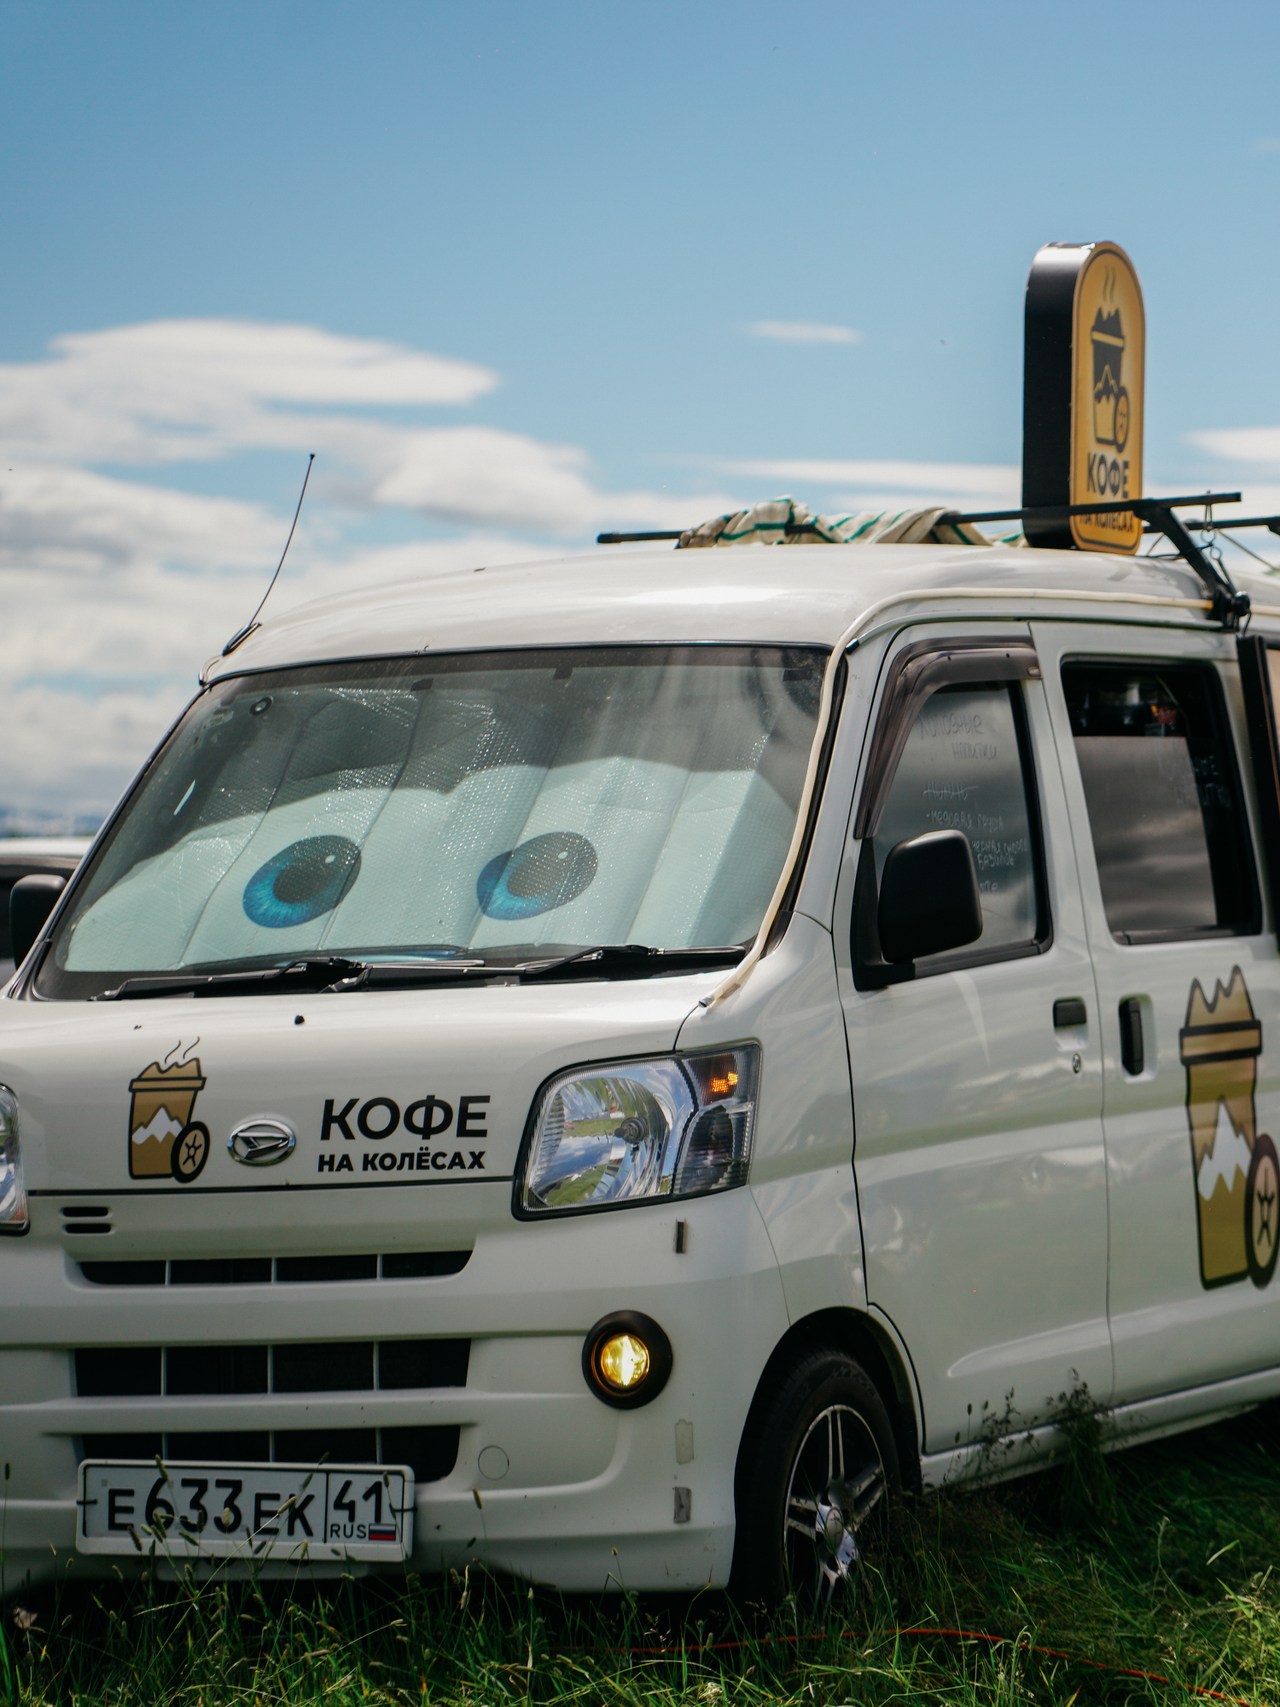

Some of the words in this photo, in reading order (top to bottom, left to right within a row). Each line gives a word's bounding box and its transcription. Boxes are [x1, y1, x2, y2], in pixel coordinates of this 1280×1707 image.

[1086, 452, 1130, 499] КОФЕ
[319, 1093, 492, 1142] КОФЕ
[317, 1152, 354, 1174] НА
[361, 1146, 487, 1173] КОЛЁСАХ
[332, 1479, 384, 1524] 41
[329, 1523, 367, 1539] RUS
